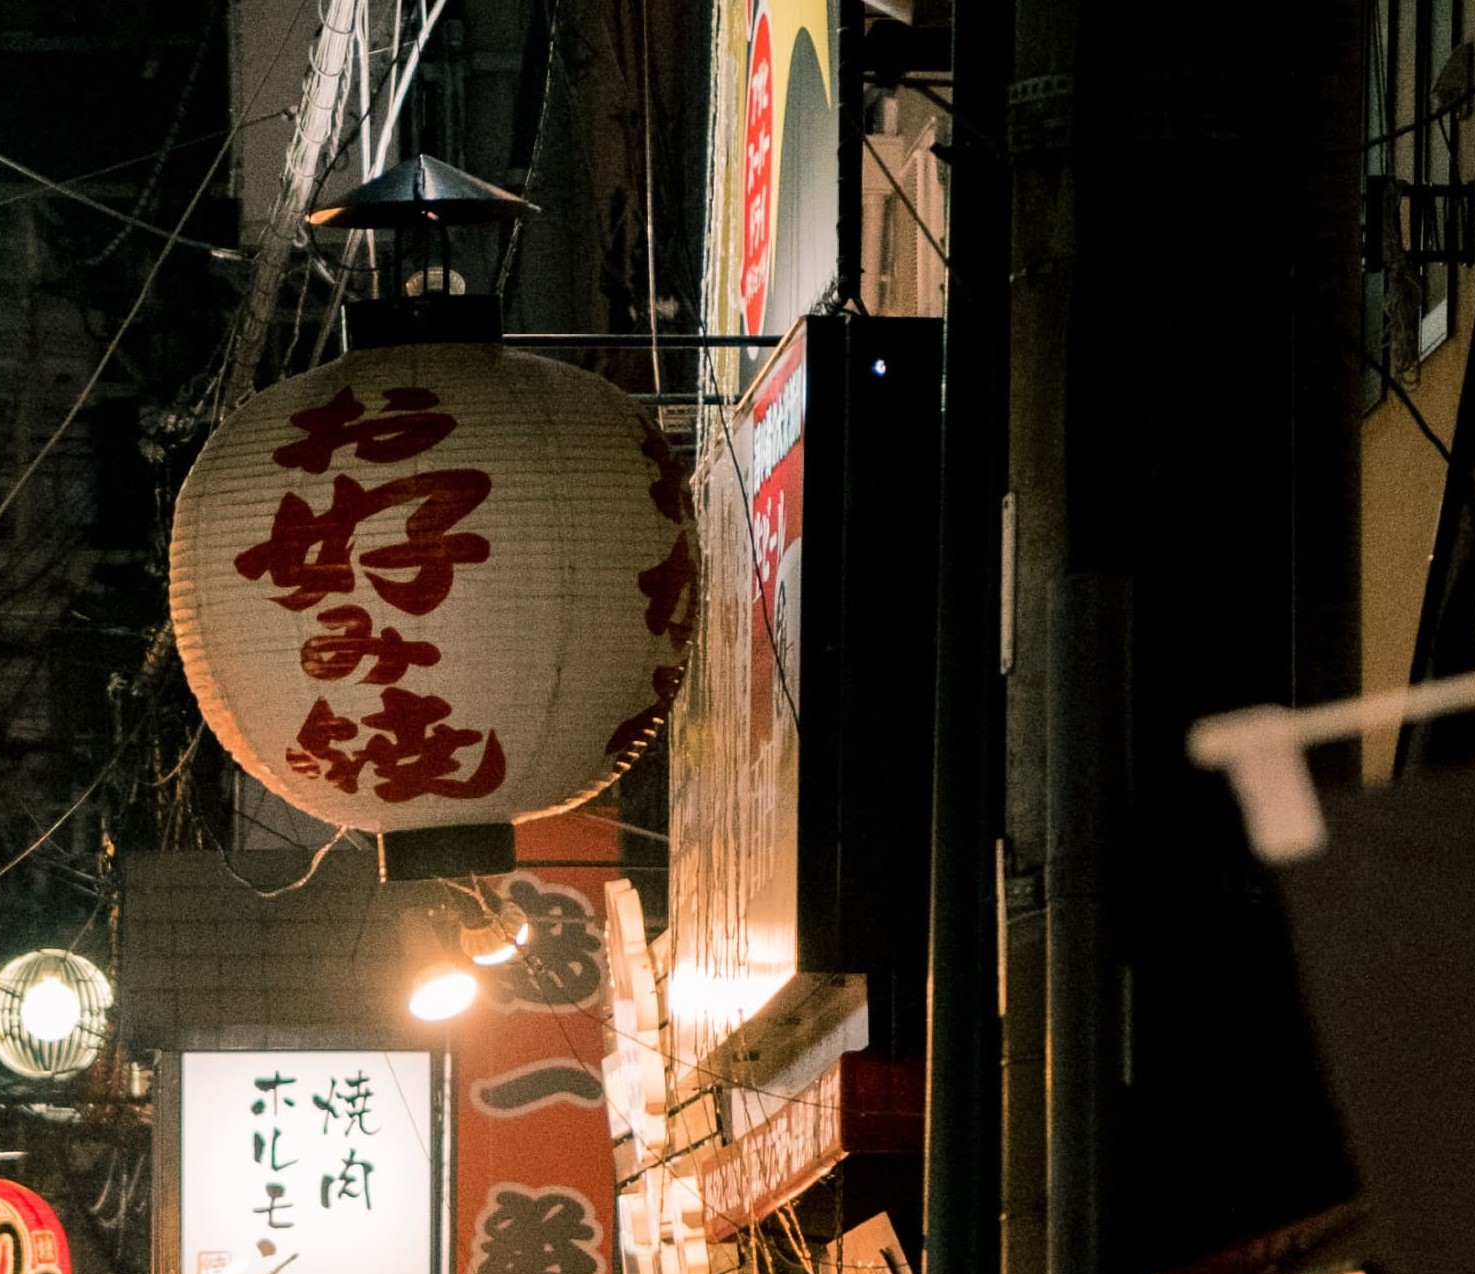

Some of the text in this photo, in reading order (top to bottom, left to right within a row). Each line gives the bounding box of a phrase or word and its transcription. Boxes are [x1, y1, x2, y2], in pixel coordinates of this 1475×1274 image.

[234, 385, 508, 804] お好み焼
[312, 1069, 383, 1211] 焼肉
